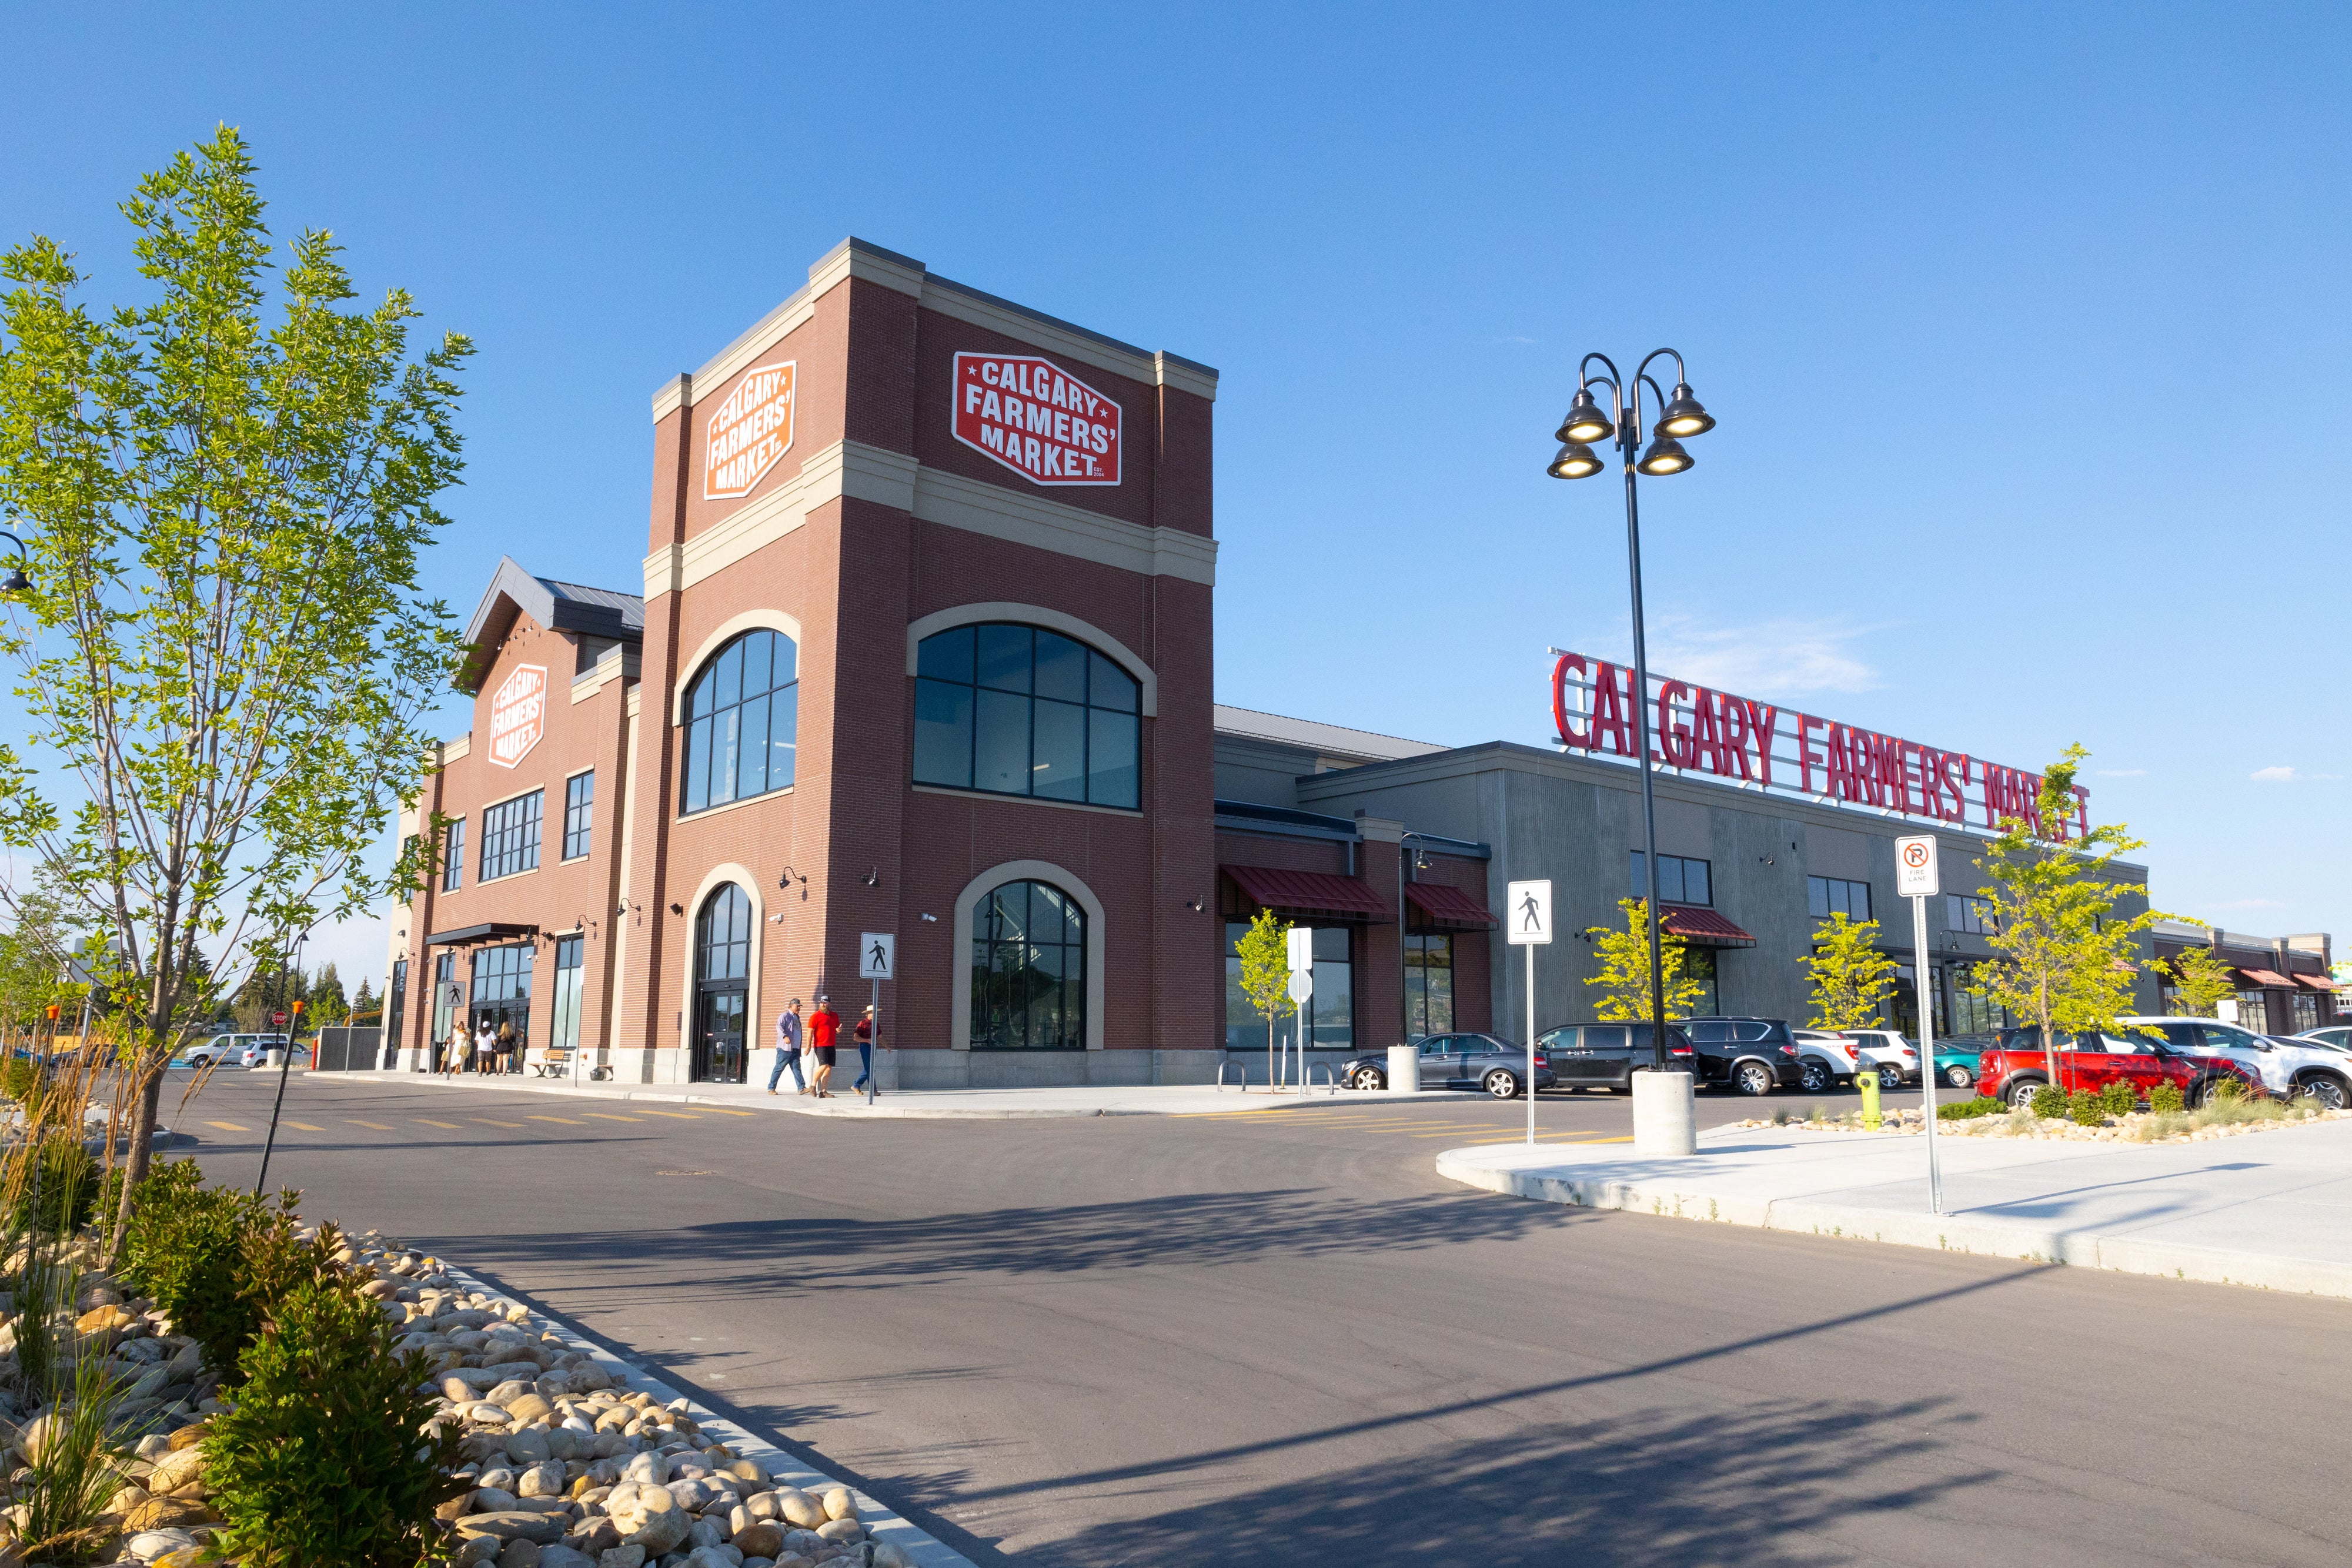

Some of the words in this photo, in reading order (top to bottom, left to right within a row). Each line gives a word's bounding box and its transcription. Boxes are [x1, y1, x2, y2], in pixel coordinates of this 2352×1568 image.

[719, 371, 781, 432] CALGARY
[982, 362, 1098, 417] CALGARY
[710, 389, 790, 470] FARMERS'
[966, 383, 1116, 454] FARMERS'
[716, 433, 777, 489] MARKET
[981, 424, 1097, 476] MARKET
[493, 691, 543, 738] FARMERS'
[499, 671, 539, 709] CALGARY
[496, 723, 534, 760] MARKET
[1553, 654, 1777, 785] CALGARY
